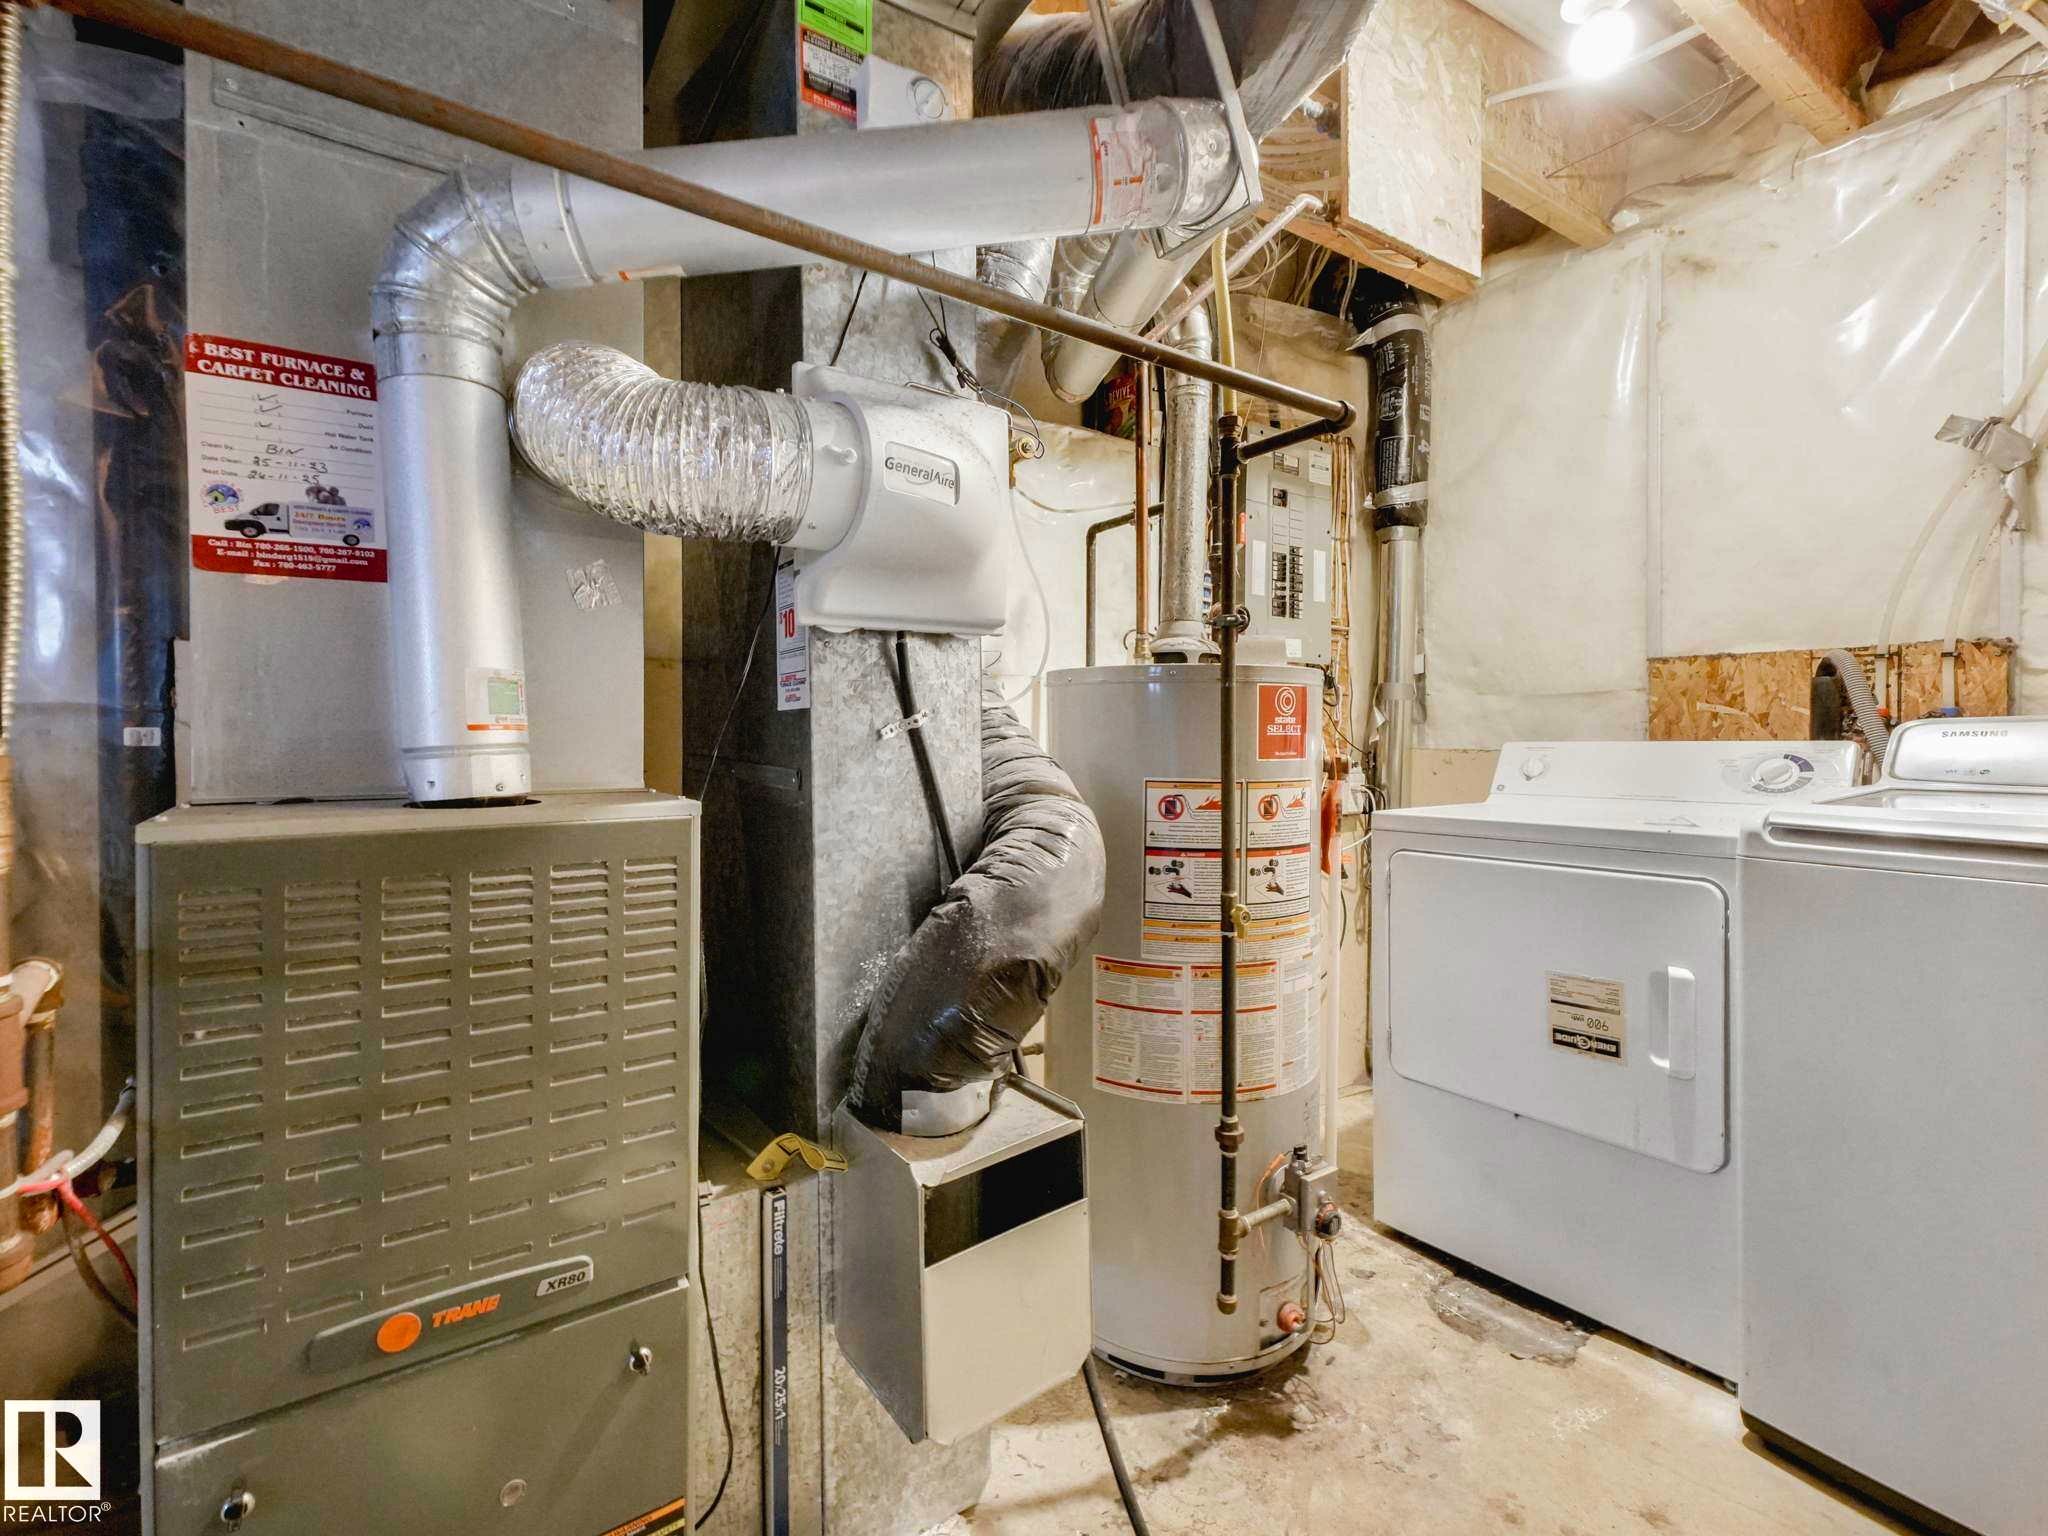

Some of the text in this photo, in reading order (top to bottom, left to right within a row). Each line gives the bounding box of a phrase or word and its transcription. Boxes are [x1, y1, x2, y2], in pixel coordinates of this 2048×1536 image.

[204, 342, 366, 381] BEST FURNACE &
[197, 359, 372, 399] CARPET CLEANING
[1109, 384, 1131, 403] REVIVE
[884, 456, 955, 489] GeneralAire
[207, 538, 228, 547] Call
[216, 548, 249, 558] E-mail
[1266, 724, 1302, 733] SELECT
[1941, 729, 2009, 738] SAMSUNG
[773, 1199, 786, 1256] Filtrete
[545, 1270, 586, 1292] XR80
[431, 1294, 502, 1328] TRANE
[774, 1366, 787, 1420] 20x25x1
